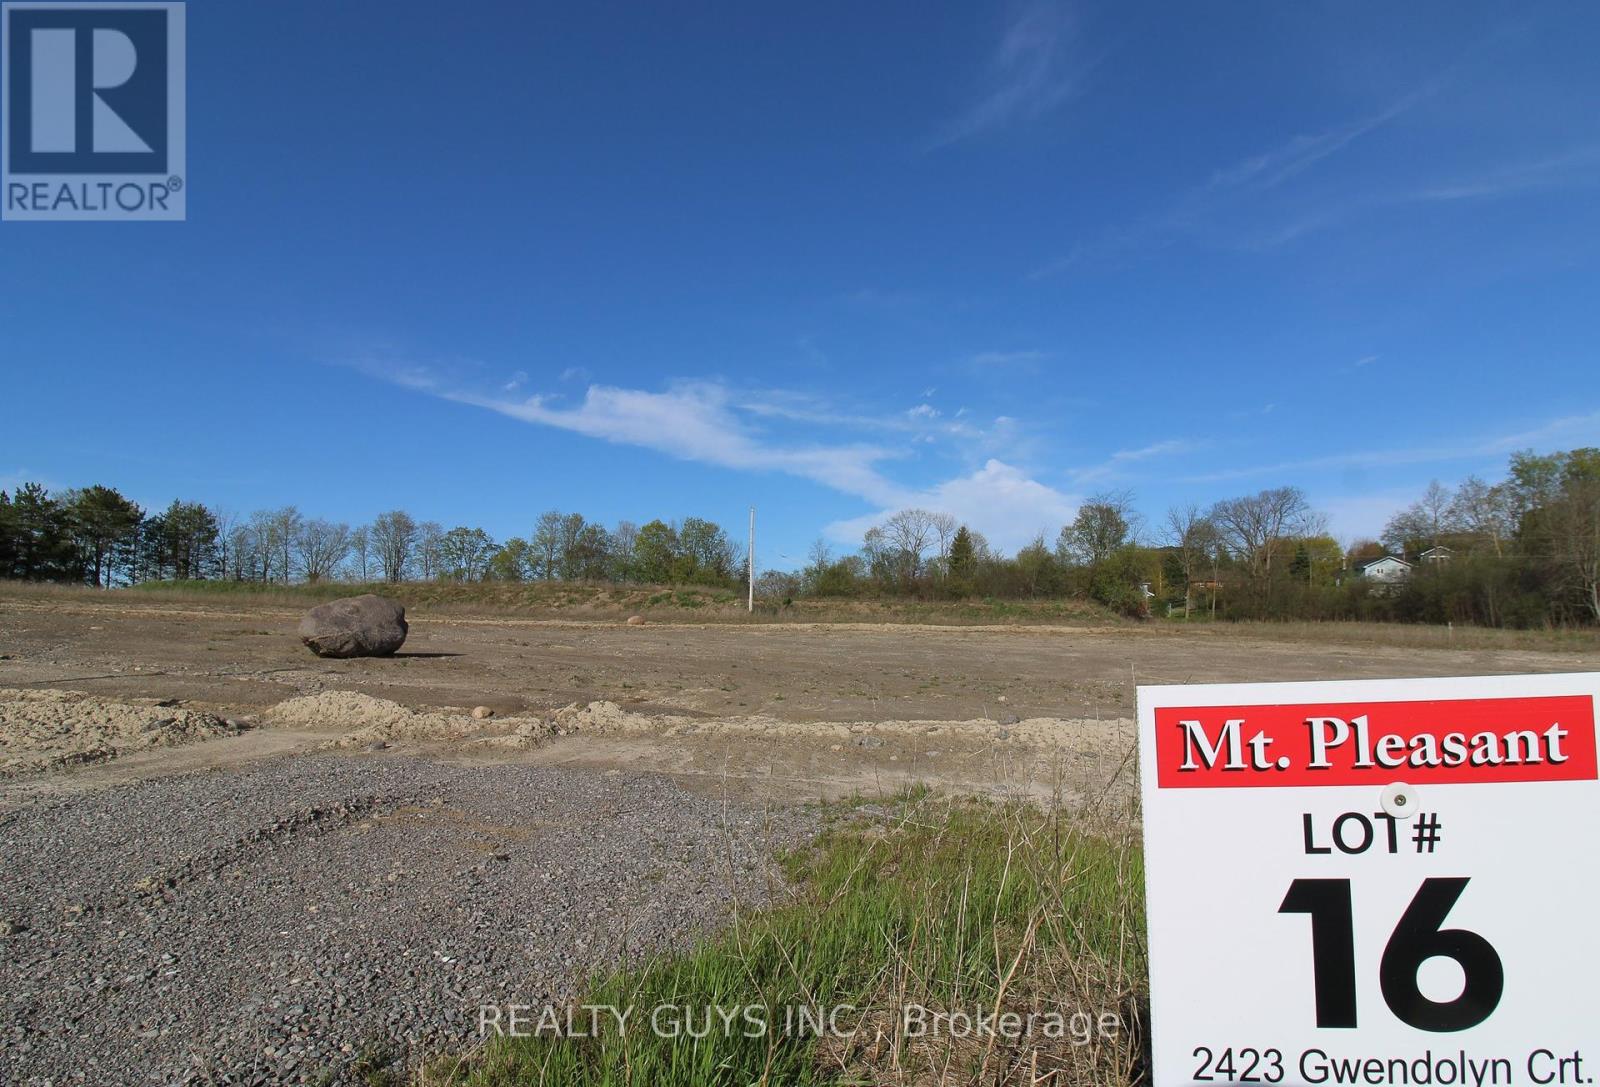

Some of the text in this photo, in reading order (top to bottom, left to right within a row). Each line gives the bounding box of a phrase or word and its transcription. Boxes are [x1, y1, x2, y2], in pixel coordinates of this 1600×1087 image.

[1177, 714, 1569, 771] Mt. Pleasant
[1278, 876, 1505, 1033] 16
[1192, 1047, 1594, 1087] 2423 Gwendolyn Crt.
